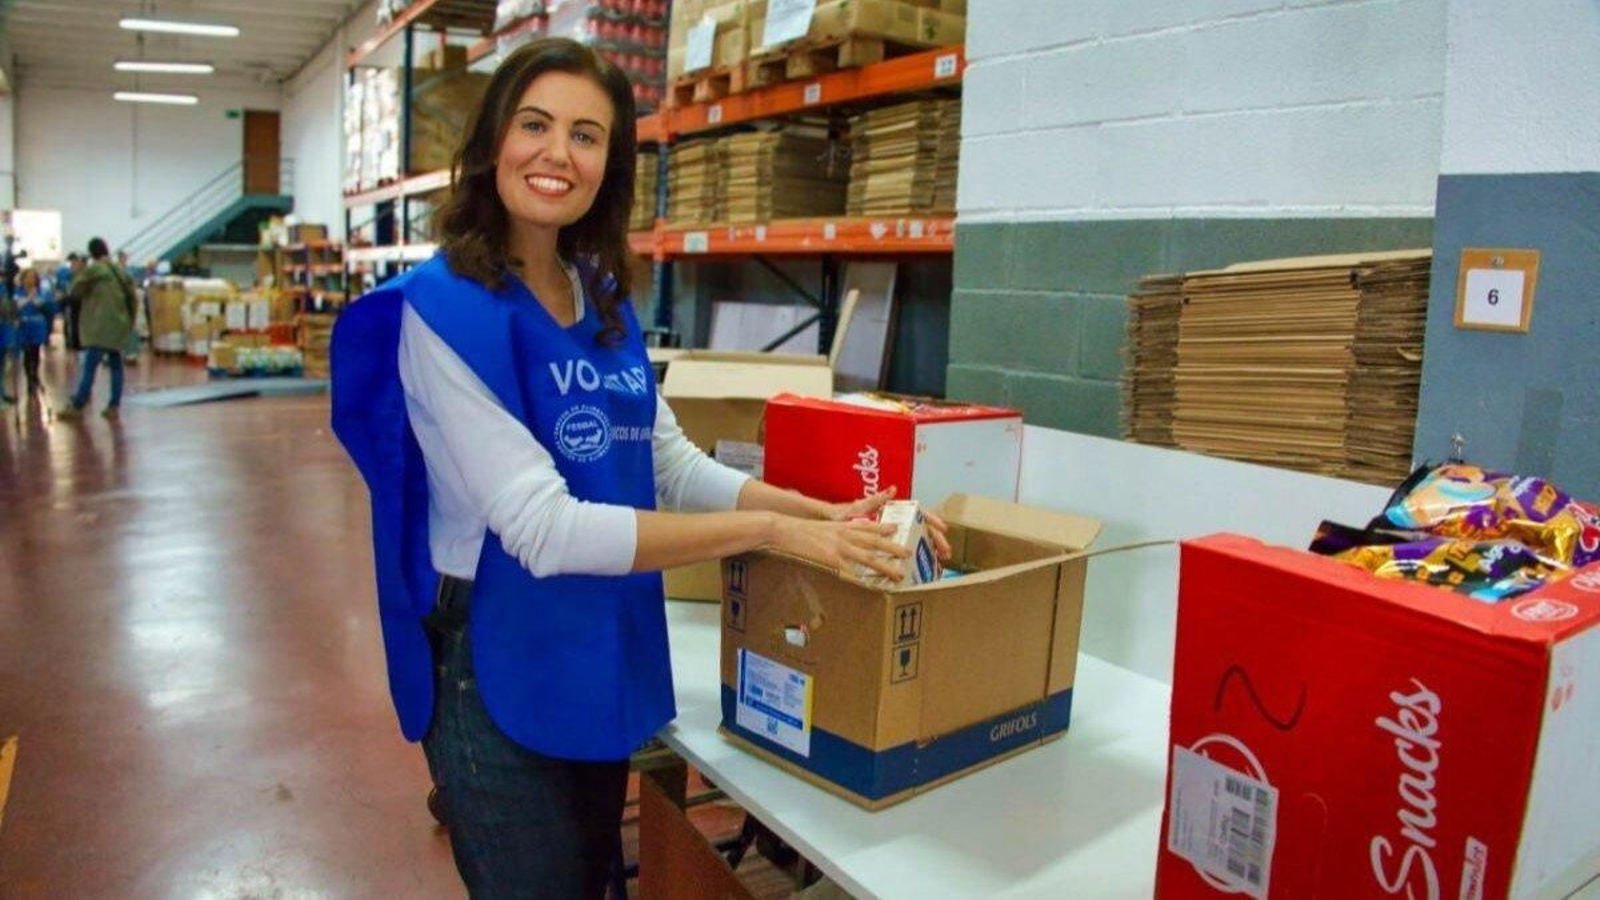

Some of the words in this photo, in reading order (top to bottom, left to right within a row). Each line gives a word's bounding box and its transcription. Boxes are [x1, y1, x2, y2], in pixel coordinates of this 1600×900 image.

[1487, 289, 1499, 306] 6
[853, 444, 879, 498] acks
[989, 711, 1038, 742] GRIFOLS
[1369, 677, 1442, 900] Snacks
